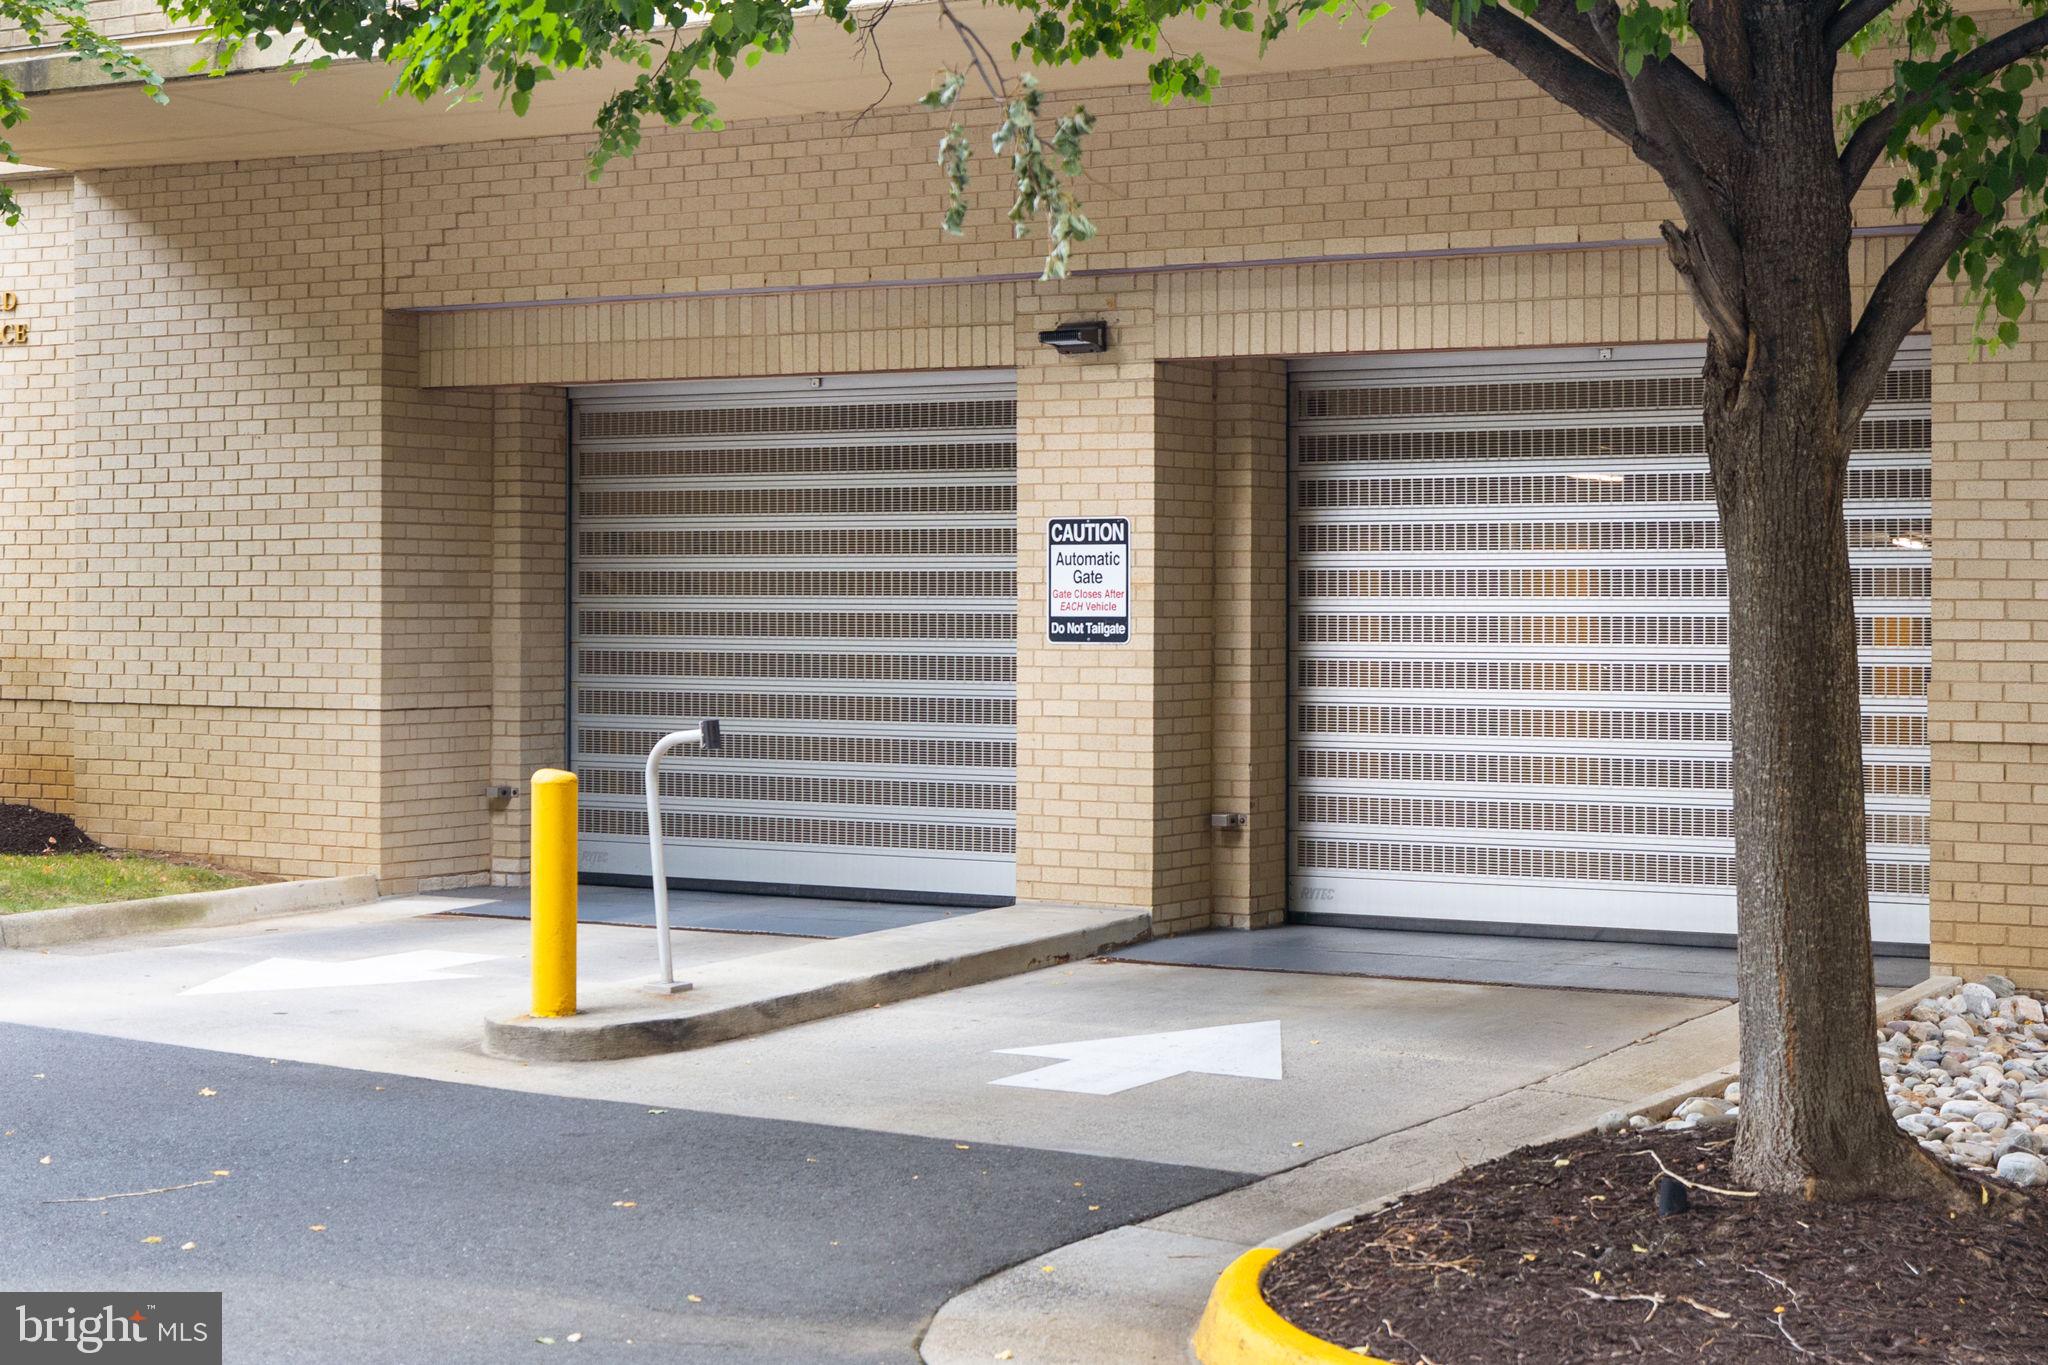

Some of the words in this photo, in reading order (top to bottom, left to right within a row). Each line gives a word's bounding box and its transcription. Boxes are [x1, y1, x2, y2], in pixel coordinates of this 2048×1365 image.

[0, 291, 17, 312] D
[0, 323, 28, 344] CE
[1051, 523, 1124, 542] CAUTION
[1056, 551, 1120, 566] Automatic
[1073, 569, 1103, 584] Gate
[1052, 589, 1072, 599] Gate
[1074, 589, 1102, 599] Closes
[1104, 589, 1124, 599] After
[1060, 602, 1083, 611] EACH
[1086, 602, 1117, 611] Vehicle
[1051, 622, 1065, 634] Do
[1067, 622, 1084, 634] Not
[1086, 622, 1126, 637] Tailgate
